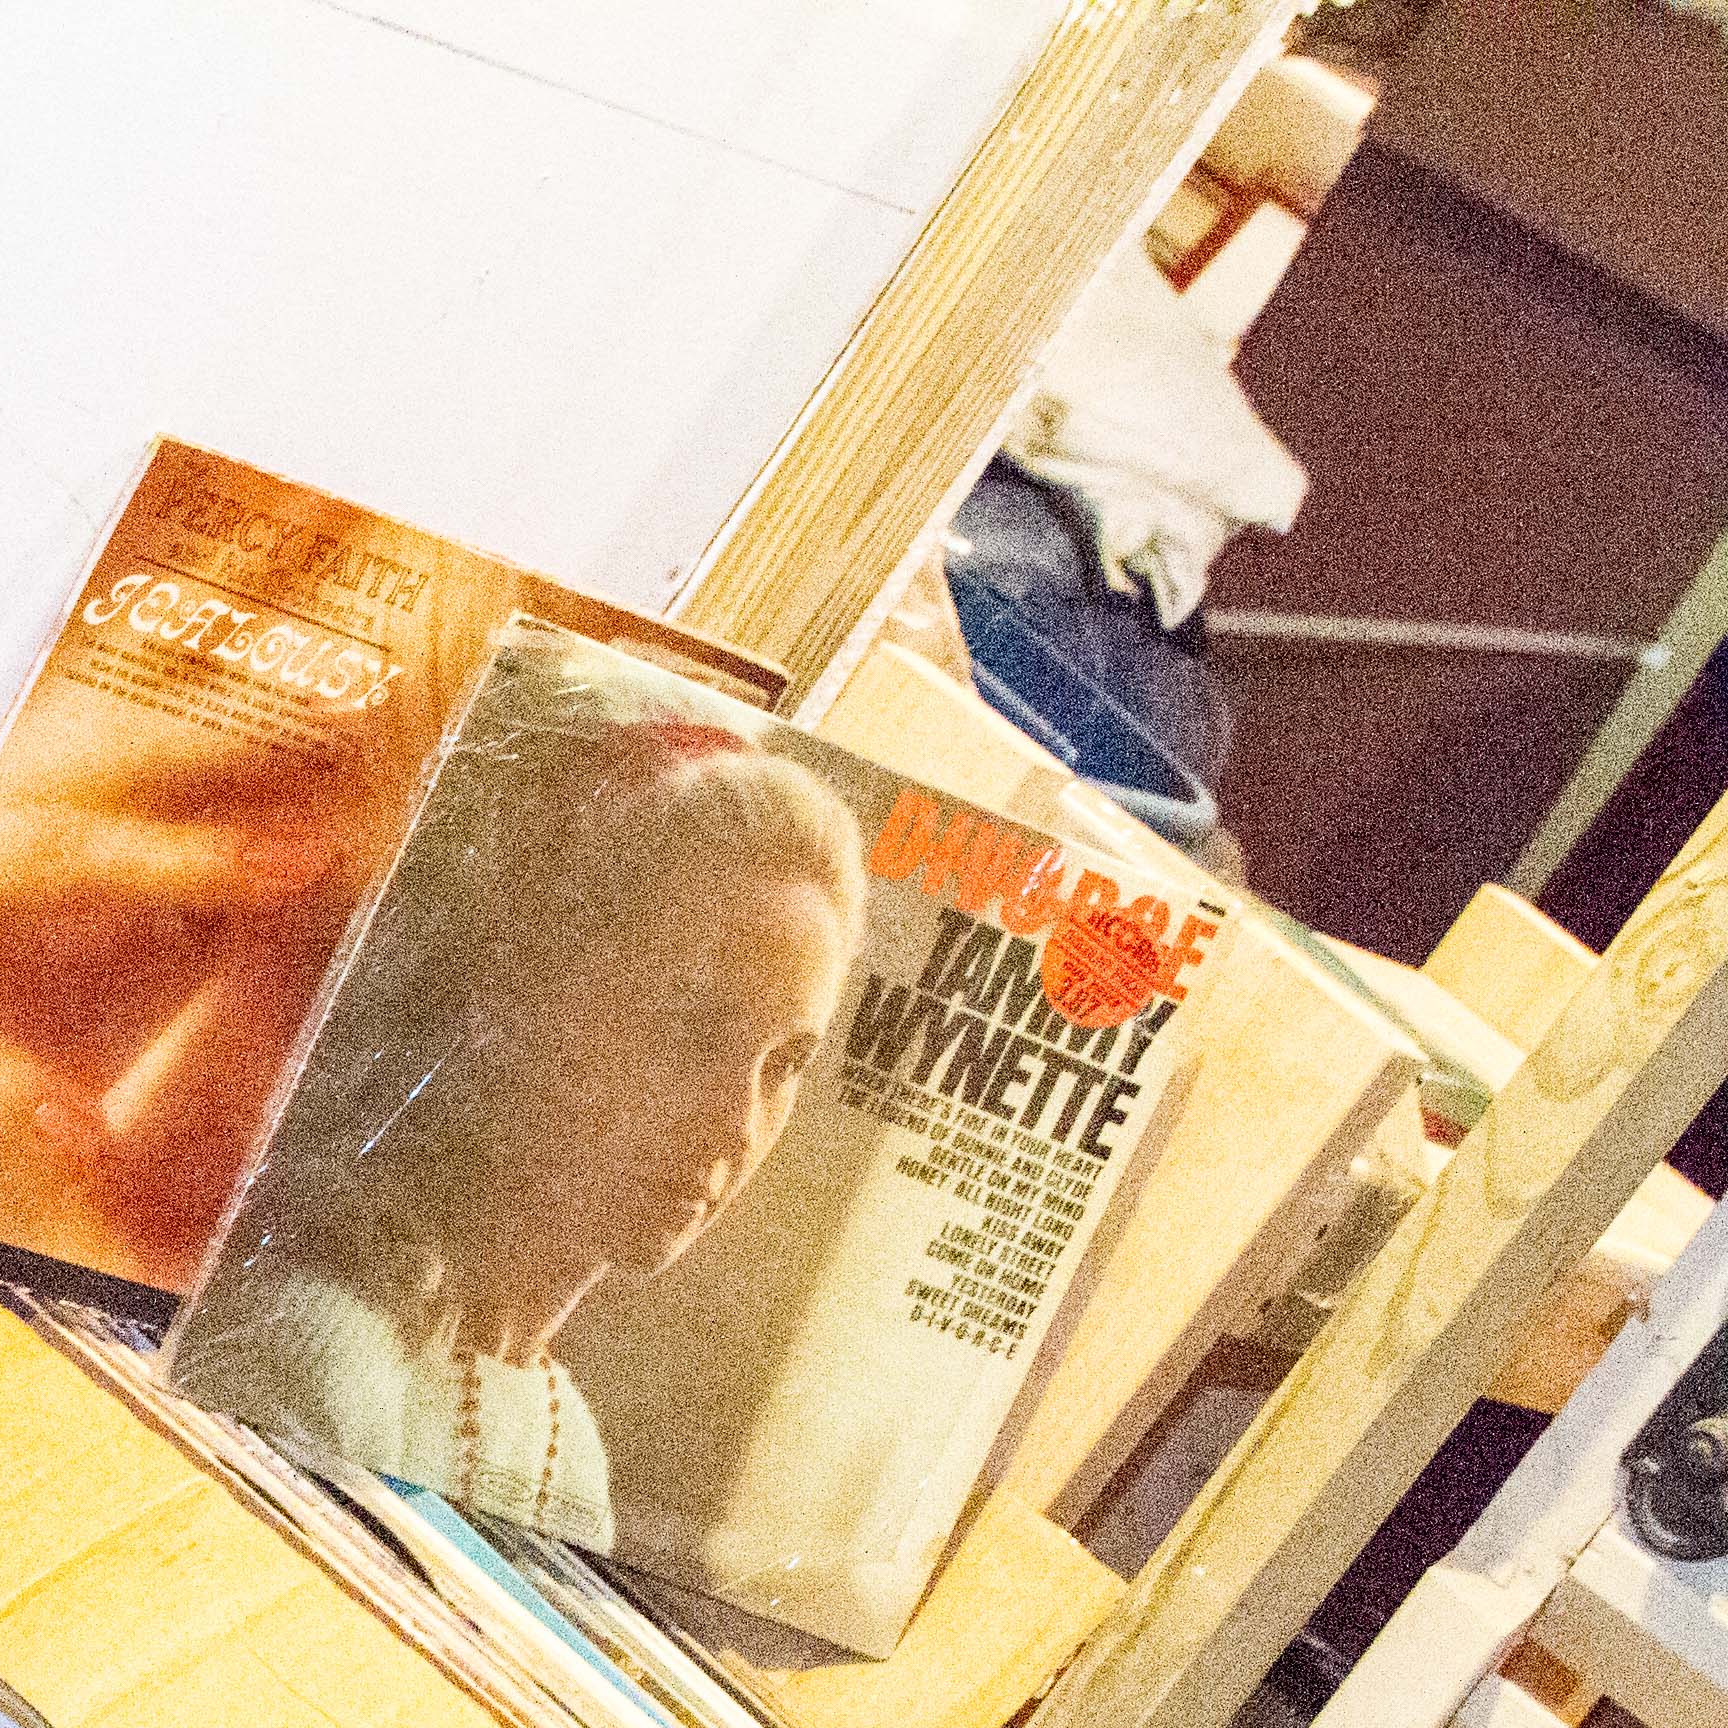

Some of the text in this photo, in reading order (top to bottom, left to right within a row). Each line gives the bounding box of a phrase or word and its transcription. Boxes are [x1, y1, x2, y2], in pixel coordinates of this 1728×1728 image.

[301, 529, 428, 613] FAITH
[845, 974, 1141, 1160] WYNETTE
[896, 1156, 948, 1189] HONEY
[1010, 1126, 1051, 1157] YOUR
[1053, 1149, 1105, 1182] HEART
[1011, 1155, 1044, 1181] AND
[1012, 1178, 1040, 1200] MY
[1044, 1192, 1086, 1222] MIND
[925, 1239, 972, 1270] COME
[999, 1270, 1046, 1299] HOME
[940, 1221, 1056, 1278] LONELY STREET
[1020, 1231, 1065, 1259] AWAY
[905, 1278, 1027, 1340] SWEET DREAMS
[951, 1274, 1038, 1318] YESTERDAY
